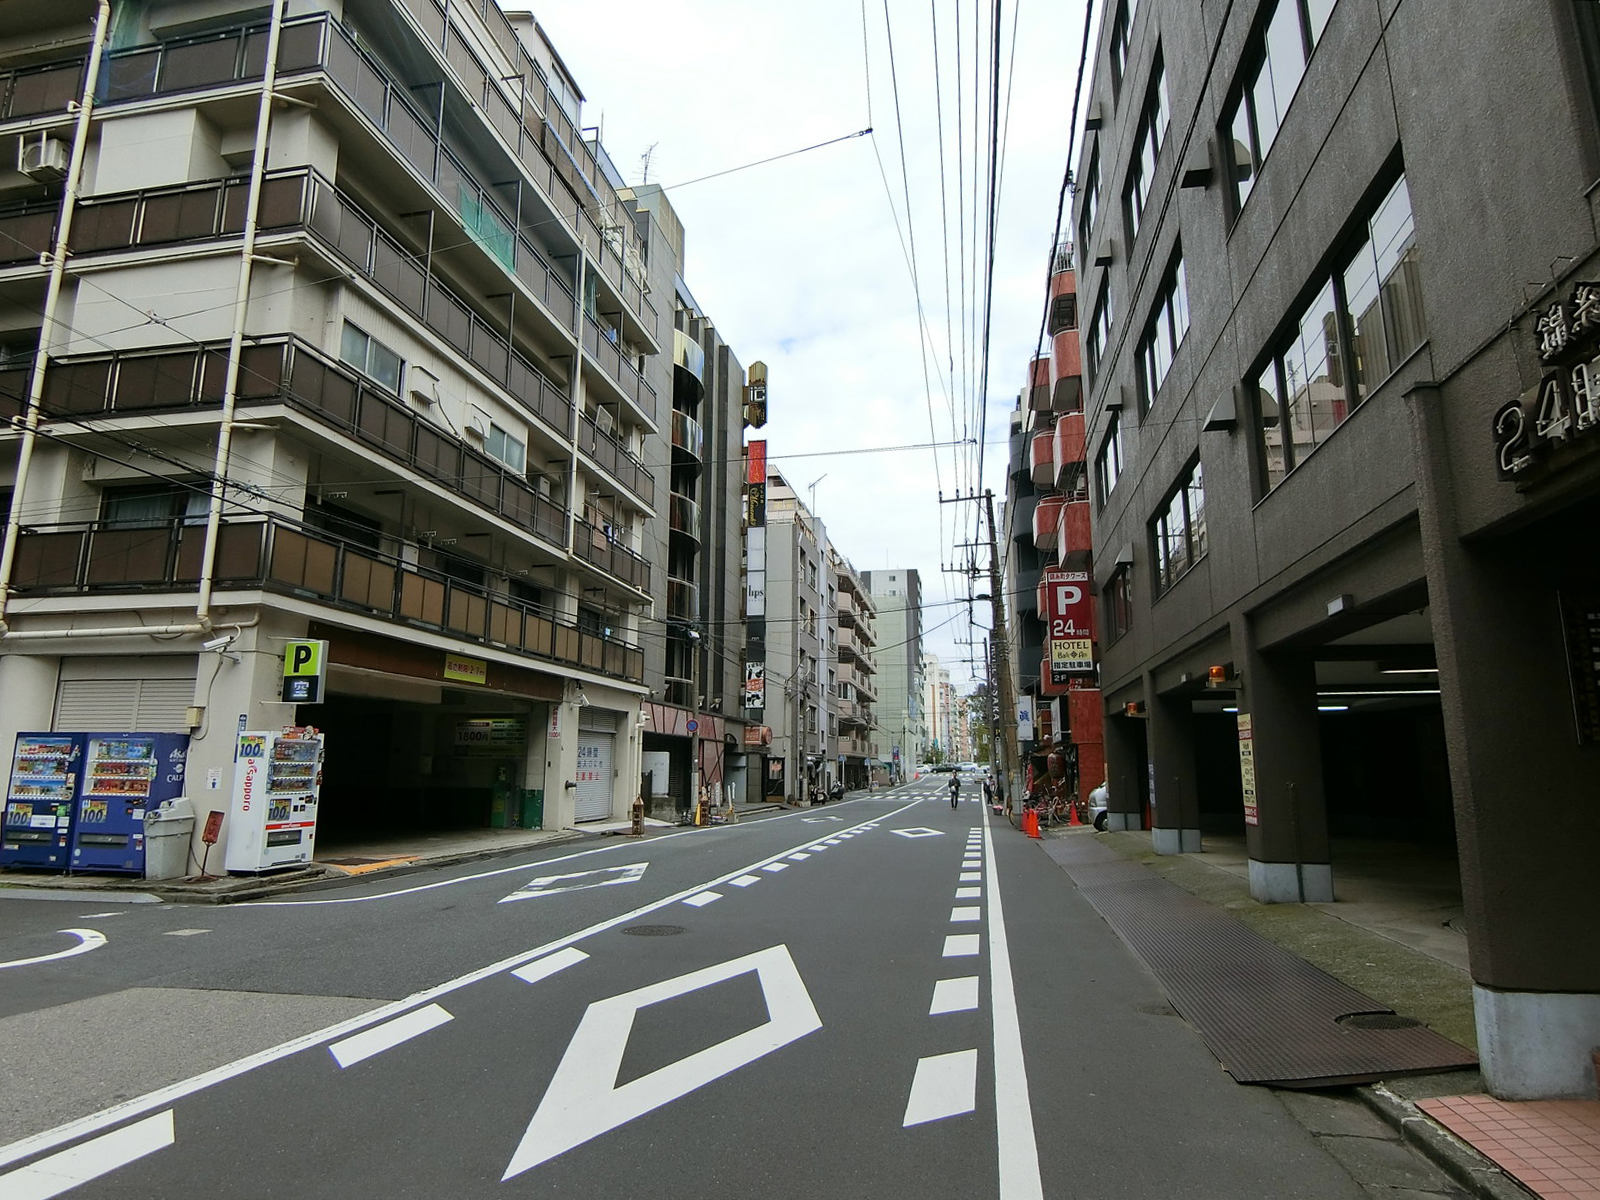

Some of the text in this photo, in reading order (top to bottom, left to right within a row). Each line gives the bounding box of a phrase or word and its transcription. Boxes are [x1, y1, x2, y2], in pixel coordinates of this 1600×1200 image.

[749, 585, 764, 599] lips
[1057, 586, 1082, 615] P
[1054, 641, 1089, 650] HOTEL
[293, 645, 312, 673] P
[293, 681, 310, 697] 空
[240, 743, 261, 758] 100
[243, 769, 254, 811] sapporo
[8, 811, 28, 825] 100
[82, 809, 104, 823] 100
[269, 807, 286, 819] 100
